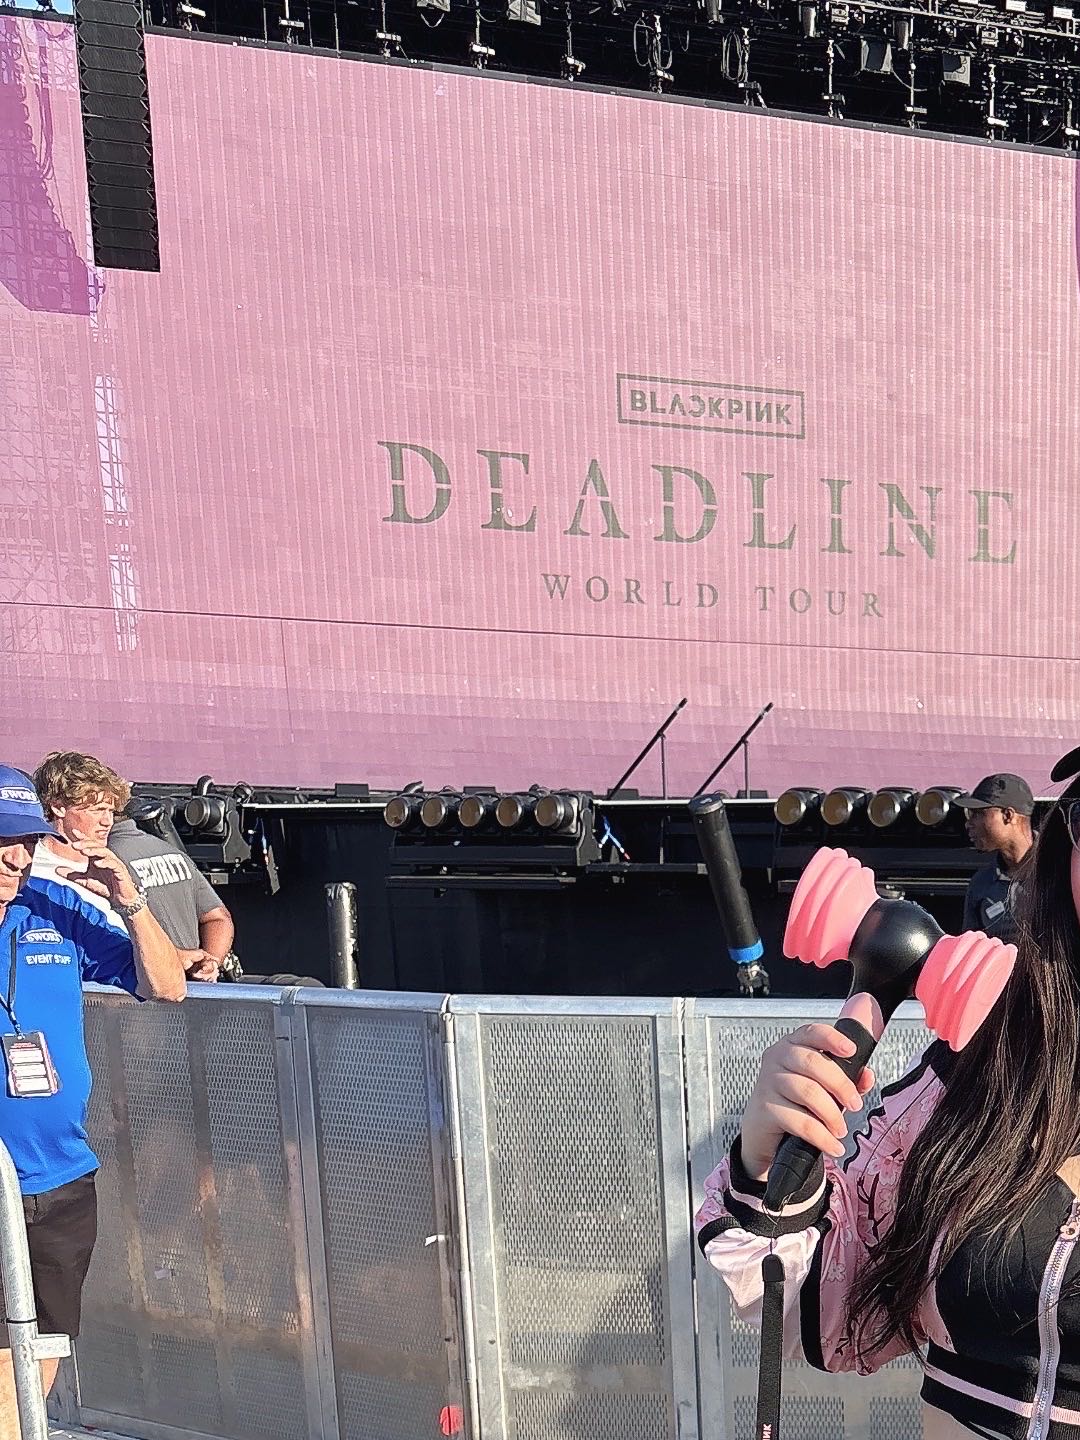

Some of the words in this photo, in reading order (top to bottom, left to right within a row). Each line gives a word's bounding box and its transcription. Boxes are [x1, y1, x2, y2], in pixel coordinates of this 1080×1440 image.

[629, 388, 793, 426] BLACKPINK
[376, 440, 1018, 565] DEADLINE
[540, 572, 720, 609] WORLD
[754, 584, 884, 619] TOUR
[25, 953, 53, 965] EVENT
